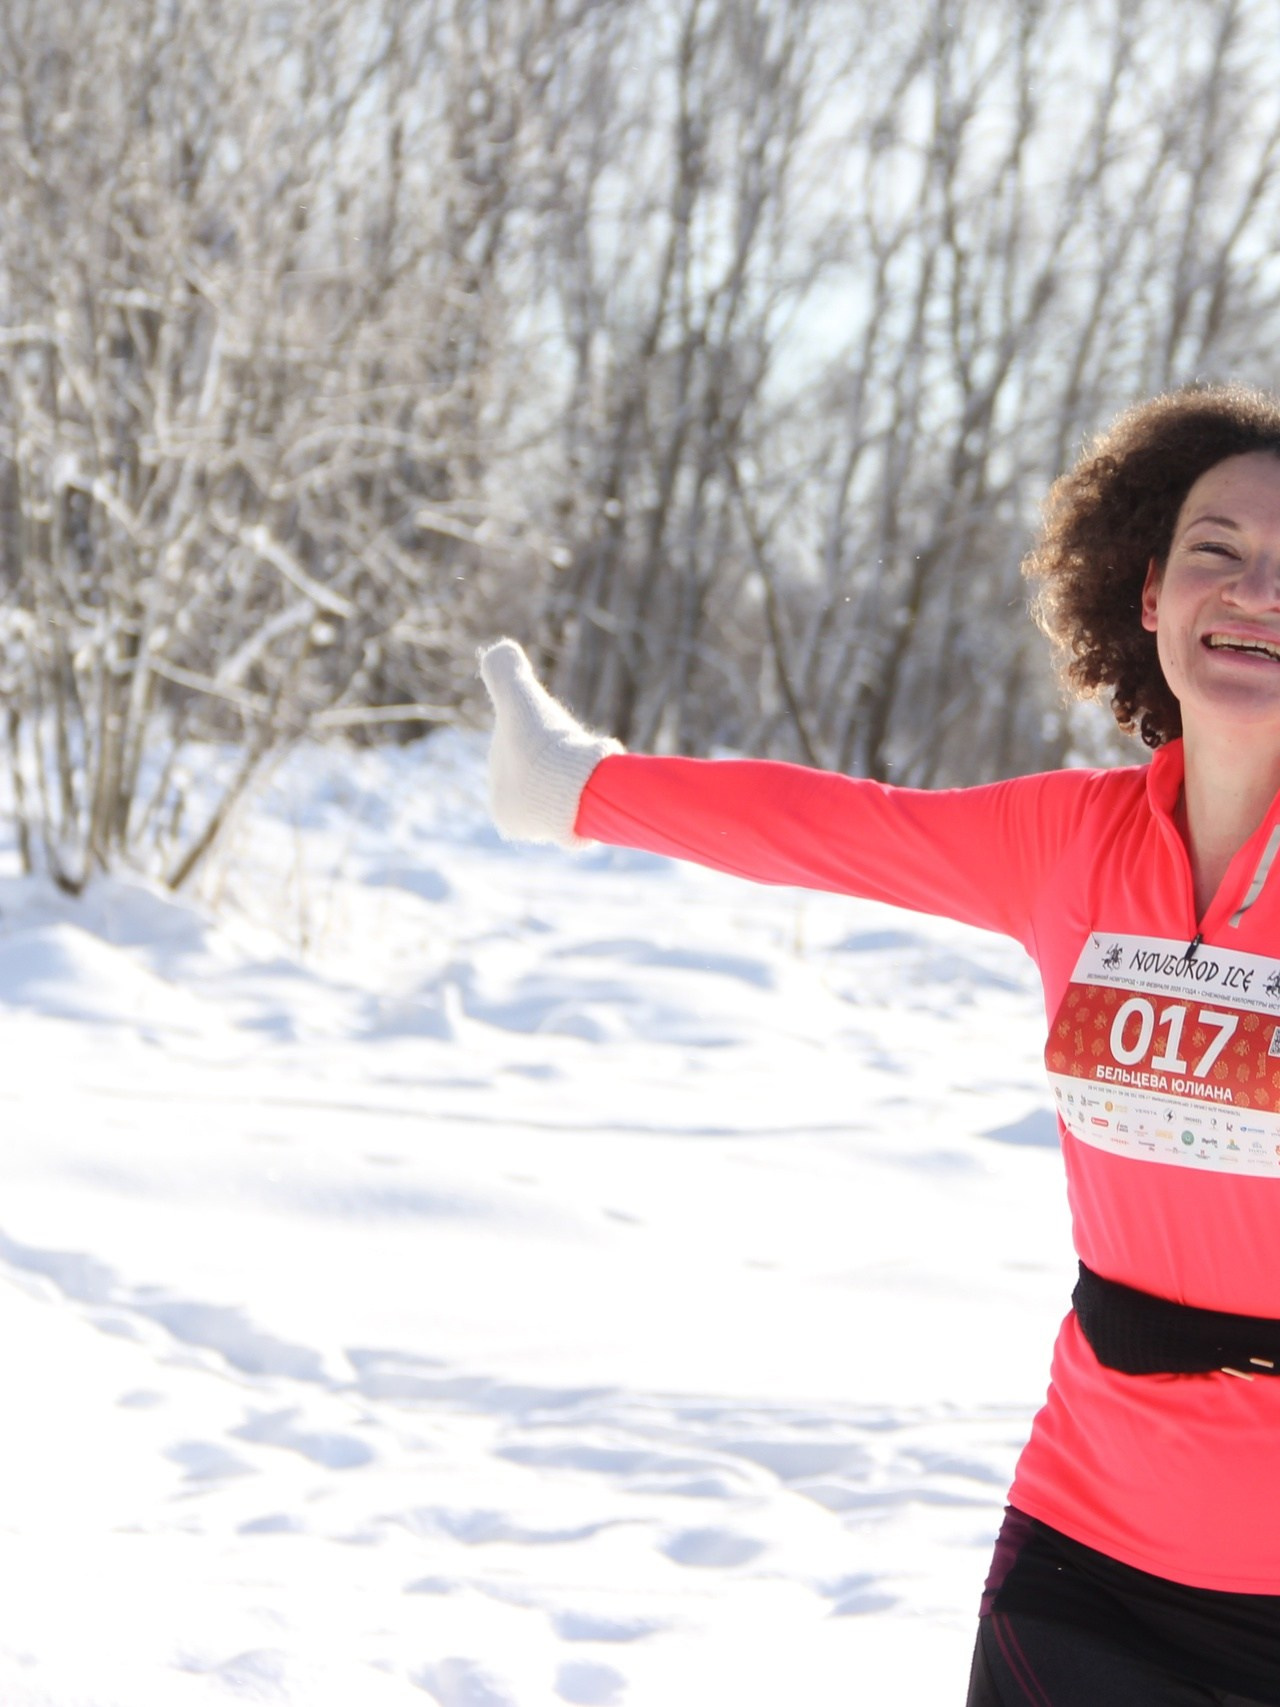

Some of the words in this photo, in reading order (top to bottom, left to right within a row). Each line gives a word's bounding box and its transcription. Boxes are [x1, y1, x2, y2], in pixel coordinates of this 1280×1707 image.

[1129, 949, 1219, 982] NOVGOROD
[1221, 966, 1254, 993] ICE
[1110, 997, 1239, 1079] 017
[1096, 1065, 1168, 1090] БЕЛЬЦЕВА
[1171, 1078, 1233, 1102] ЮЛИАНА
